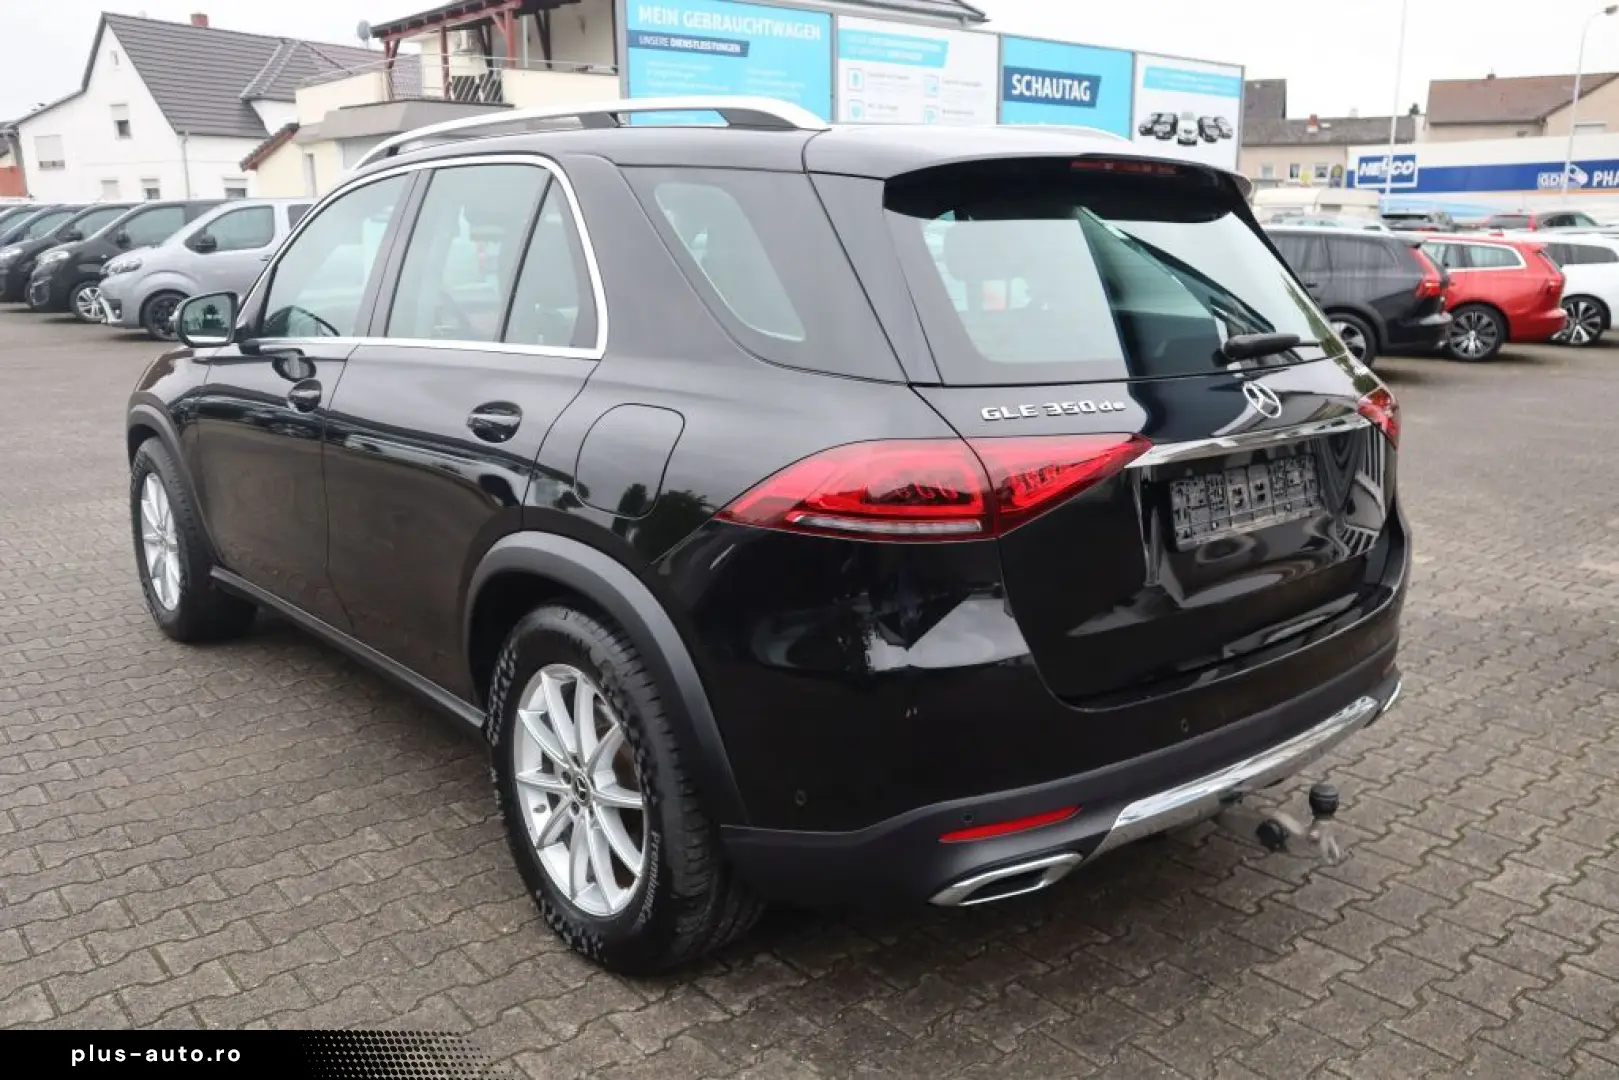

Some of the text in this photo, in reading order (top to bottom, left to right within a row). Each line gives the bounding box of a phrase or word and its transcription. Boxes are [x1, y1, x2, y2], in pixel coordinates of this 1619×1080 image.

[638, 6, 821, 40] MEIN GEBRAUCHTWAGEN
[1011, 73, 1091, 102] SCHAUTAG
[981, 404, 1039, 421] GLE
